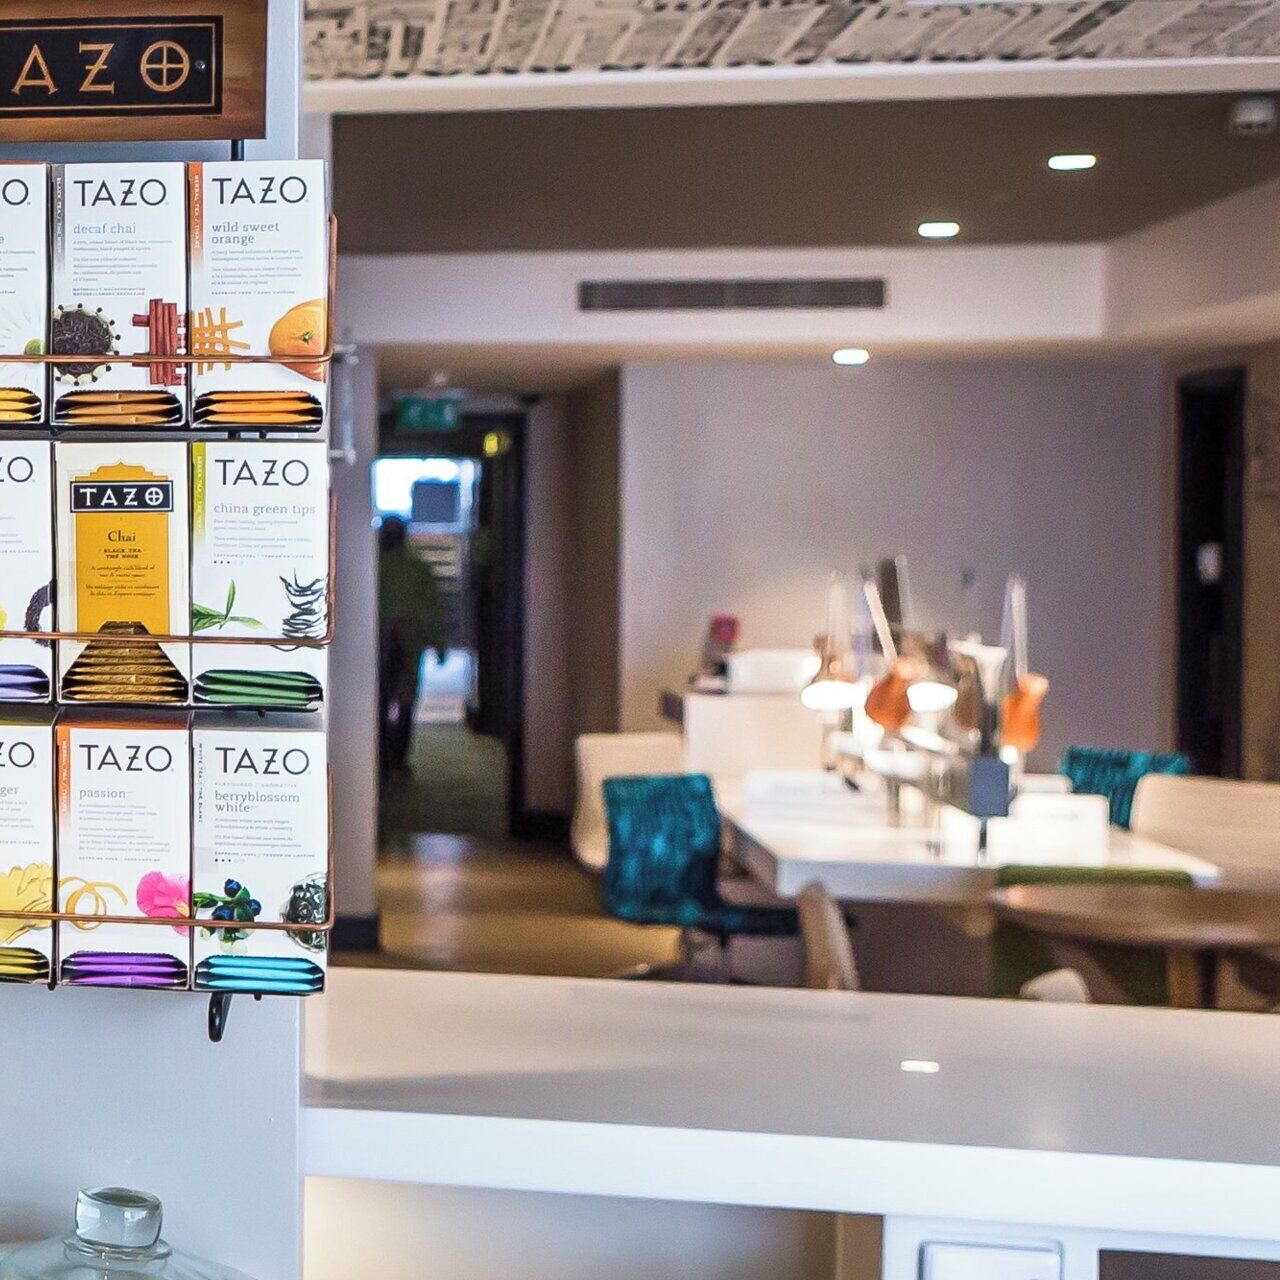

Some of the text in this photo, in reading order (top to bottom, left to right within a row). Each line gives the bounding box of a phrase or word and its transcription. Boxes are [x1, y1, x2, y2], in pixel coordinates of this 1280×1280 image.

[73, 178, 167, 206] TAZO
[211, 176, 307, 205] TAZO
[73, 223, 136, 234] decaf chai
[212, 222, 280, 232] wild sweet
[212, 235, 255, 246] orange
[214, 460, 309, 486] TAZO
[79, 487, 164, 506] TAZO
[214, 504, 316, 516] china green tips
[107, 530, 136, 542] Chai
[79, 744, 172, 772] TAZO
[215, 747, 309, 775] TAZO
[79, 789, 126, 801] passion
[214, 790, 300, 804] berryblossom
[215, 802, 250, 813] white
